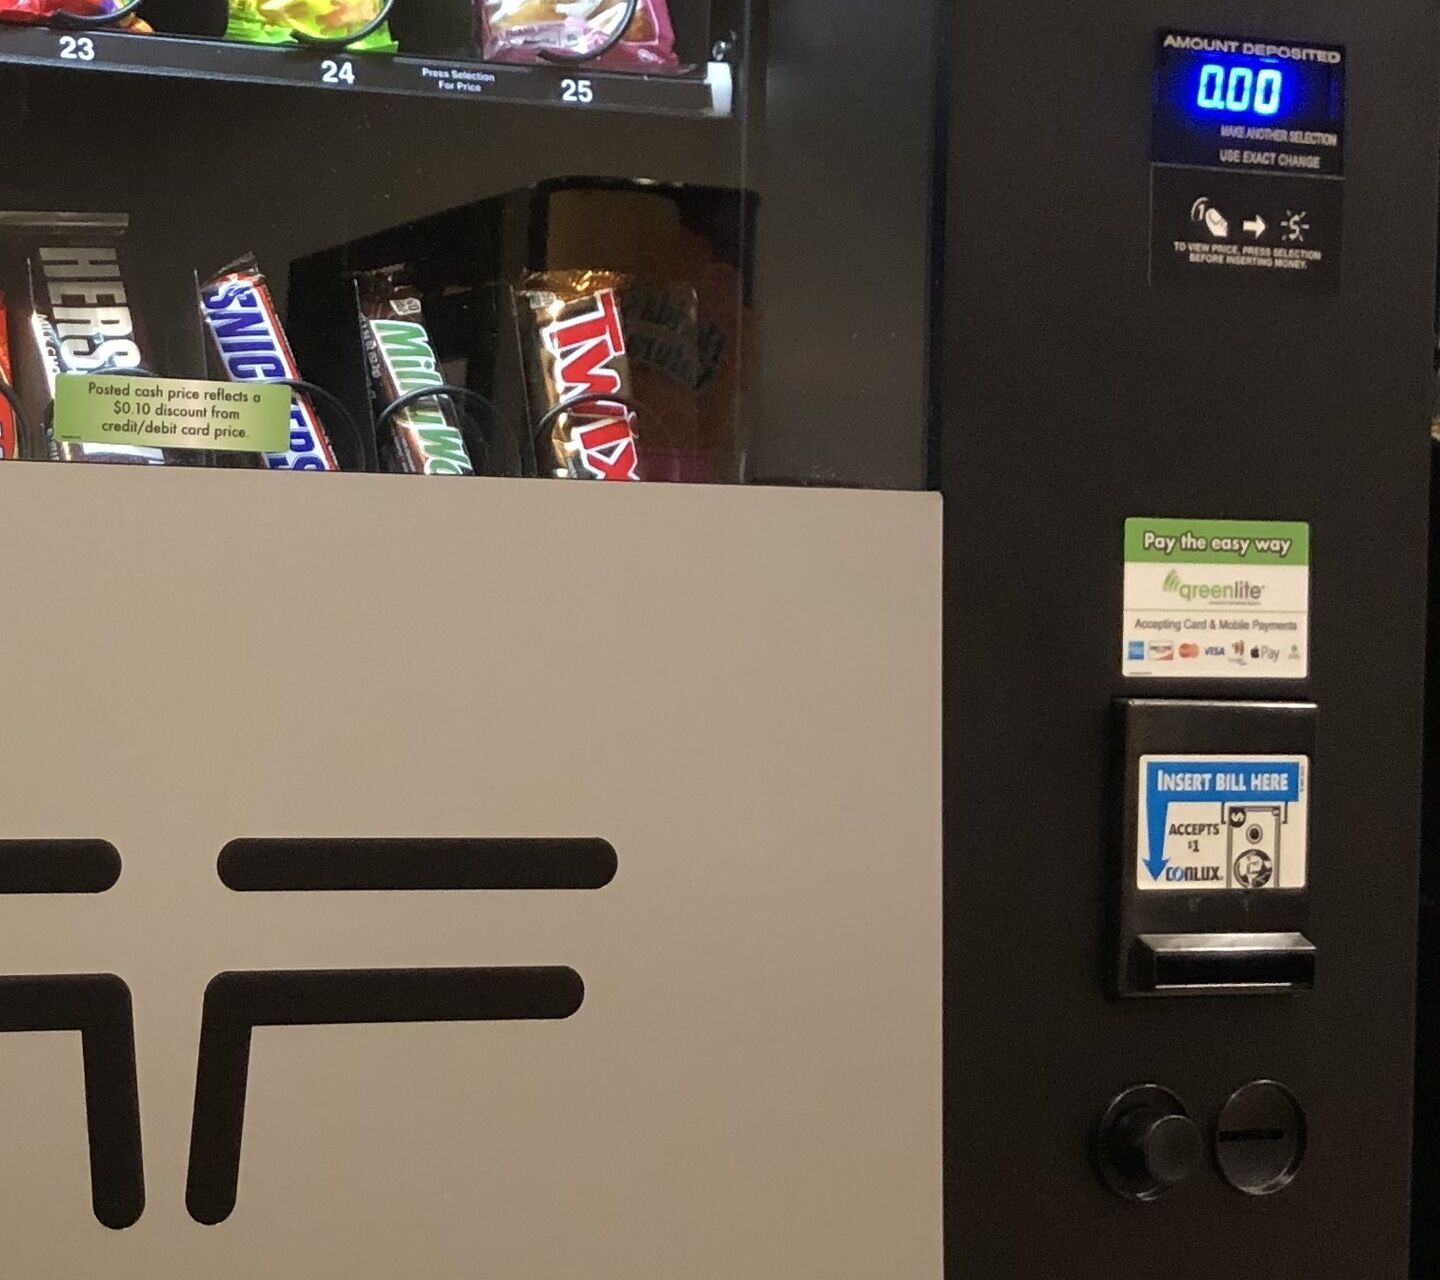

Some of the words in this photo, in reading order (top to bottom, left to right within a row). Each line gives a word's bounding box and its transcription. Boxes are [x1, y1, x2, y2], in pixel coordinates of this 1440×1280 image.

[59, 36, 95, 61] 23
[1164, 35, 1239, 53] AMOUNT
[1242, 42, 1341, 63] DEPOSITED
[320, 59, 355, 85] 24
[422, 67, 448, 80] Press
[452, 69, 496, 83] Selection
[438, 79, 455, 91] For
[457, 80, 482, 93] Price
[561, 77, 594, 103] 25
[1197, 64, 1283, 115] 0.00
[1220, 124, 1245, 139] MAKE
[1246, 127, 1288, 142] ANOTHER
[1288, 130, 1338, 146] SELECTION
[1220, 149, 1241, 163] USE
[1243, 151, 1276, 166] EXACT
[1278, 153, 1321, 168] CHANGE
[1174, 241, 1187, 251] TO
[1188, 242, 1210, 253] VIEW
[1242, 246, 1271, 257] PRESS
[1273, 248, 1322, 260] SELECTION
[1189, 253, 1224, 263] BEFORE
[1226, 255, 1273, 267] INSERTING
[88, 382, 130, 397] Posted
[134, 384, 164, 399] cash
[167, 387, 200, 403] price
[203, 387, 249, 403] reflects
[253, 392, 261, 403] a
[113, 401, 151, 417] $0.10
[155, 404, 208, 420] discount
[211, 406, 240, 420] from
[101, 419, 178, 436] credit/debit
[181, 422, 210, 437] card
[1144, 532, 1177, 554] Pay
[1181, 532, 1207, 550] the
[1212, 537, 1250, 557] easy
[1255, 538, 1291, 558] way
[1179, 581, 1262, 601] greenlite
[1135, 618, 1181, 632] Accepting
[1183, 619, 1207, 630] Card
[1209, 620, 1216, 630] &
[1219, 620, 1250, 631] Mobile
[1252, 620, 1298, 632] Payments
[1204, 646, 1225, 656] VISA
[1261, 646, 1280, 663] Pay
[1157, 770, 1212, 792] INSERT
[1215, 773, 1246, 791] BILL
[1251, 772, 1289, 791] HERE
[1168, 823, 1220, 836] ACCEPTS
